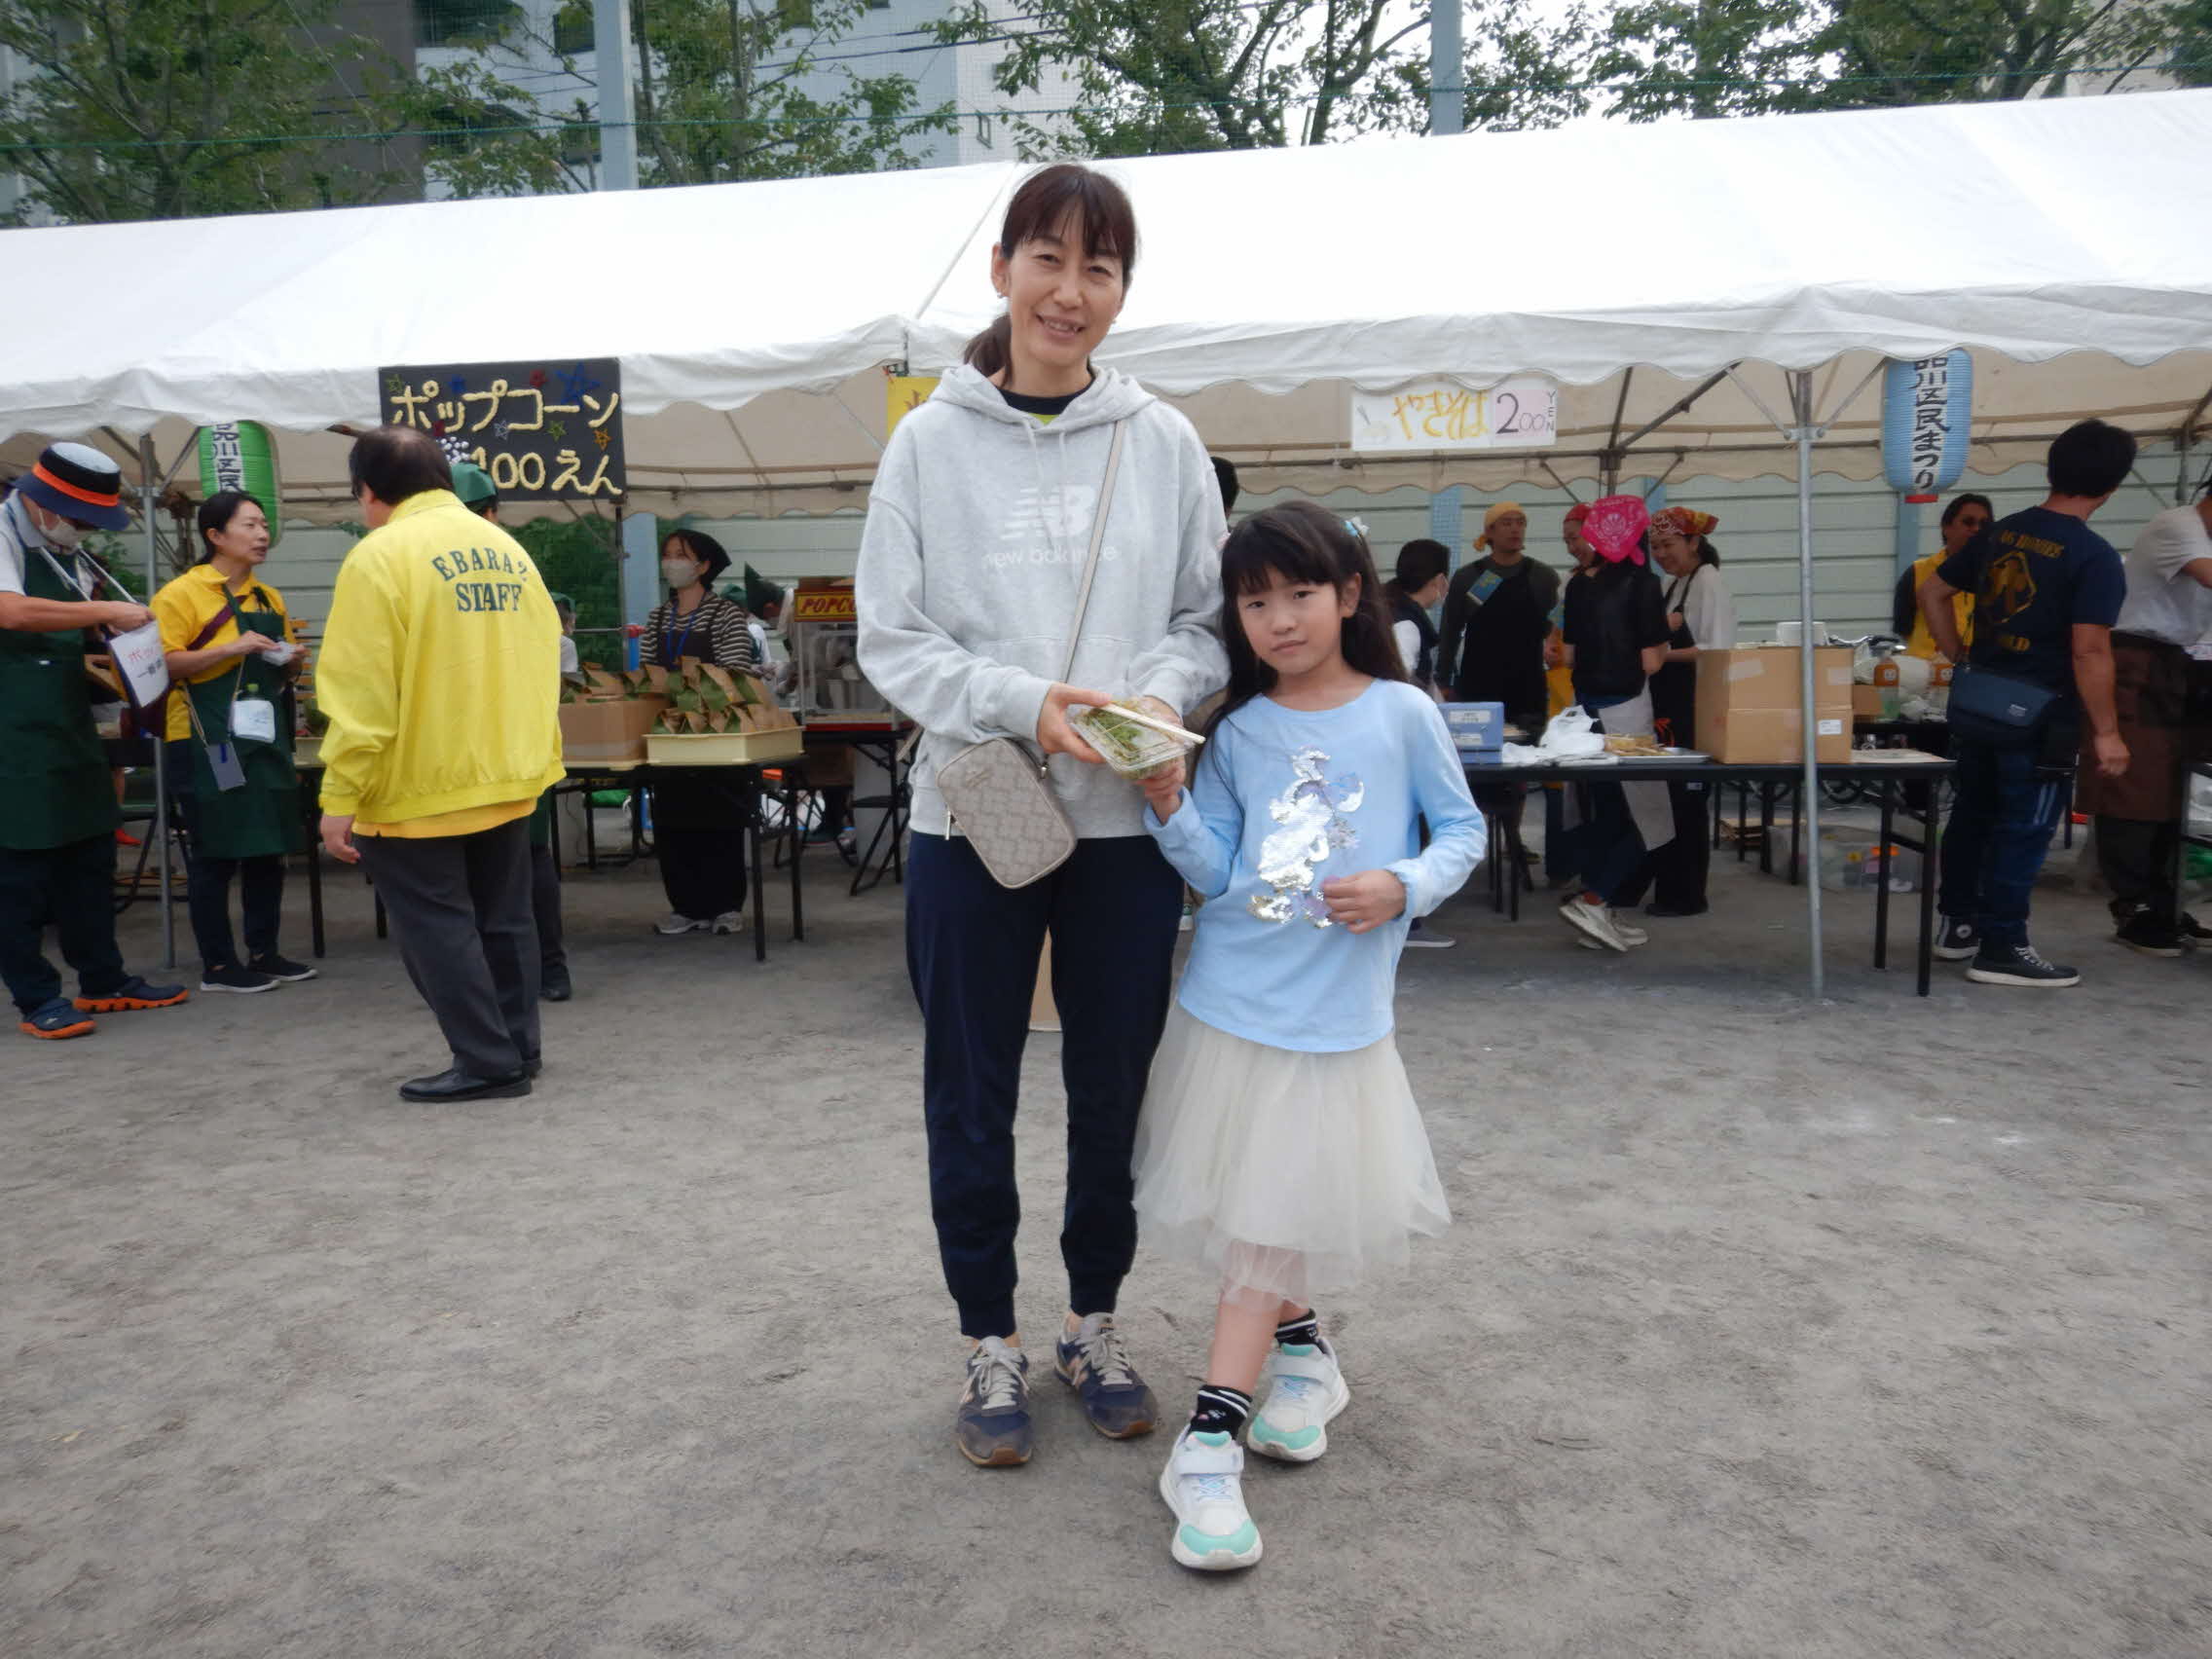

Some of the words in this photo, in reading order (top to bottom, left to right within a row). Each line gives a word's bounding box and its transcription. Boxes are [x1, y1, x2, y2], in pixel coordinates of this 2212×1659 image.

[390, 379, 619, 433] ポップコーン
[1392, 389, 1490, 441] やきそば
[1496, 392, 1546, 434] 200
[1909, 356, 1951, 490] 品川区民まつり
[431, 547, 514, 582] EBARA
[455, 582, 522, 612] STAFF
